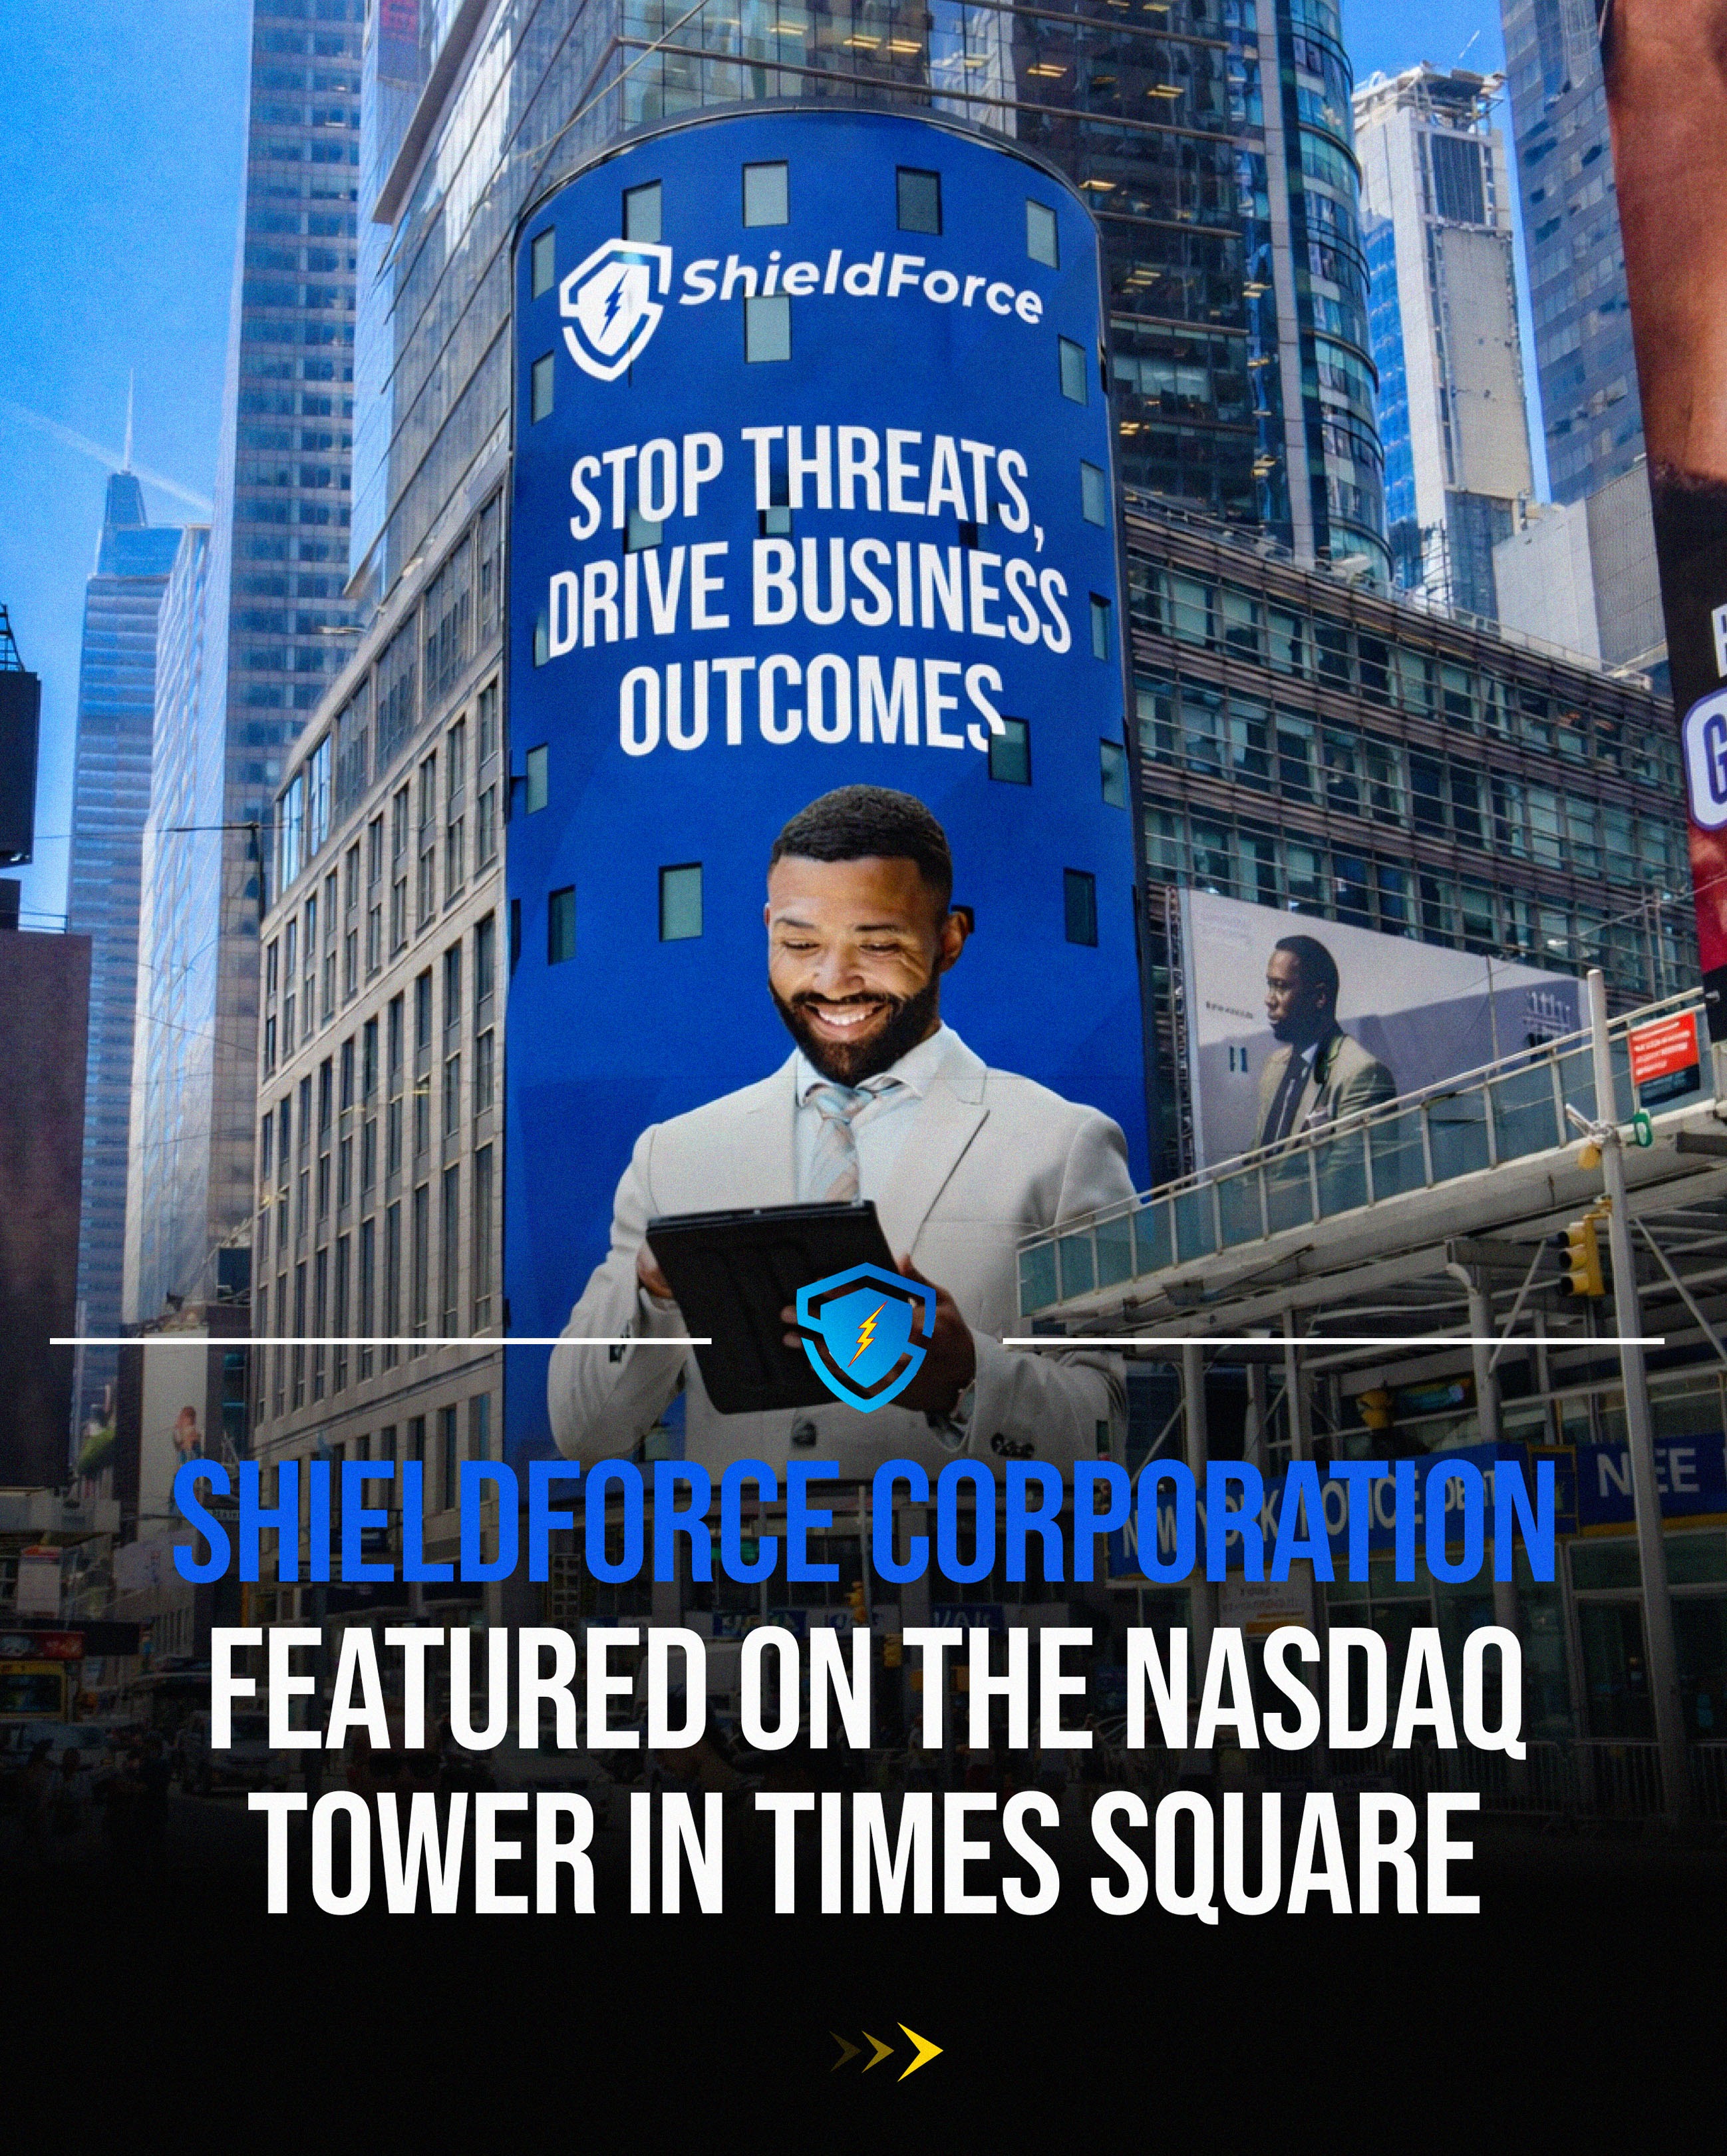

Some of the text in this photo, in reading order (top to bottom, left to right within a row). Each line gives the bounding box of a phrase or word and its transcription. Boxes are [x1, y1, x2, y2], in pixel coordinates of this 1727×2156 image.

[680, 249, 1043, 324] ShieldForce
[571, 425, 1044, 552] STOP THREATS,
[550, 537, 1072, 657] DRIVE BUSINESS
[620, 653, 1007, 756] OUTCOMES
[1123, 1505, 1181, 1558] NW
